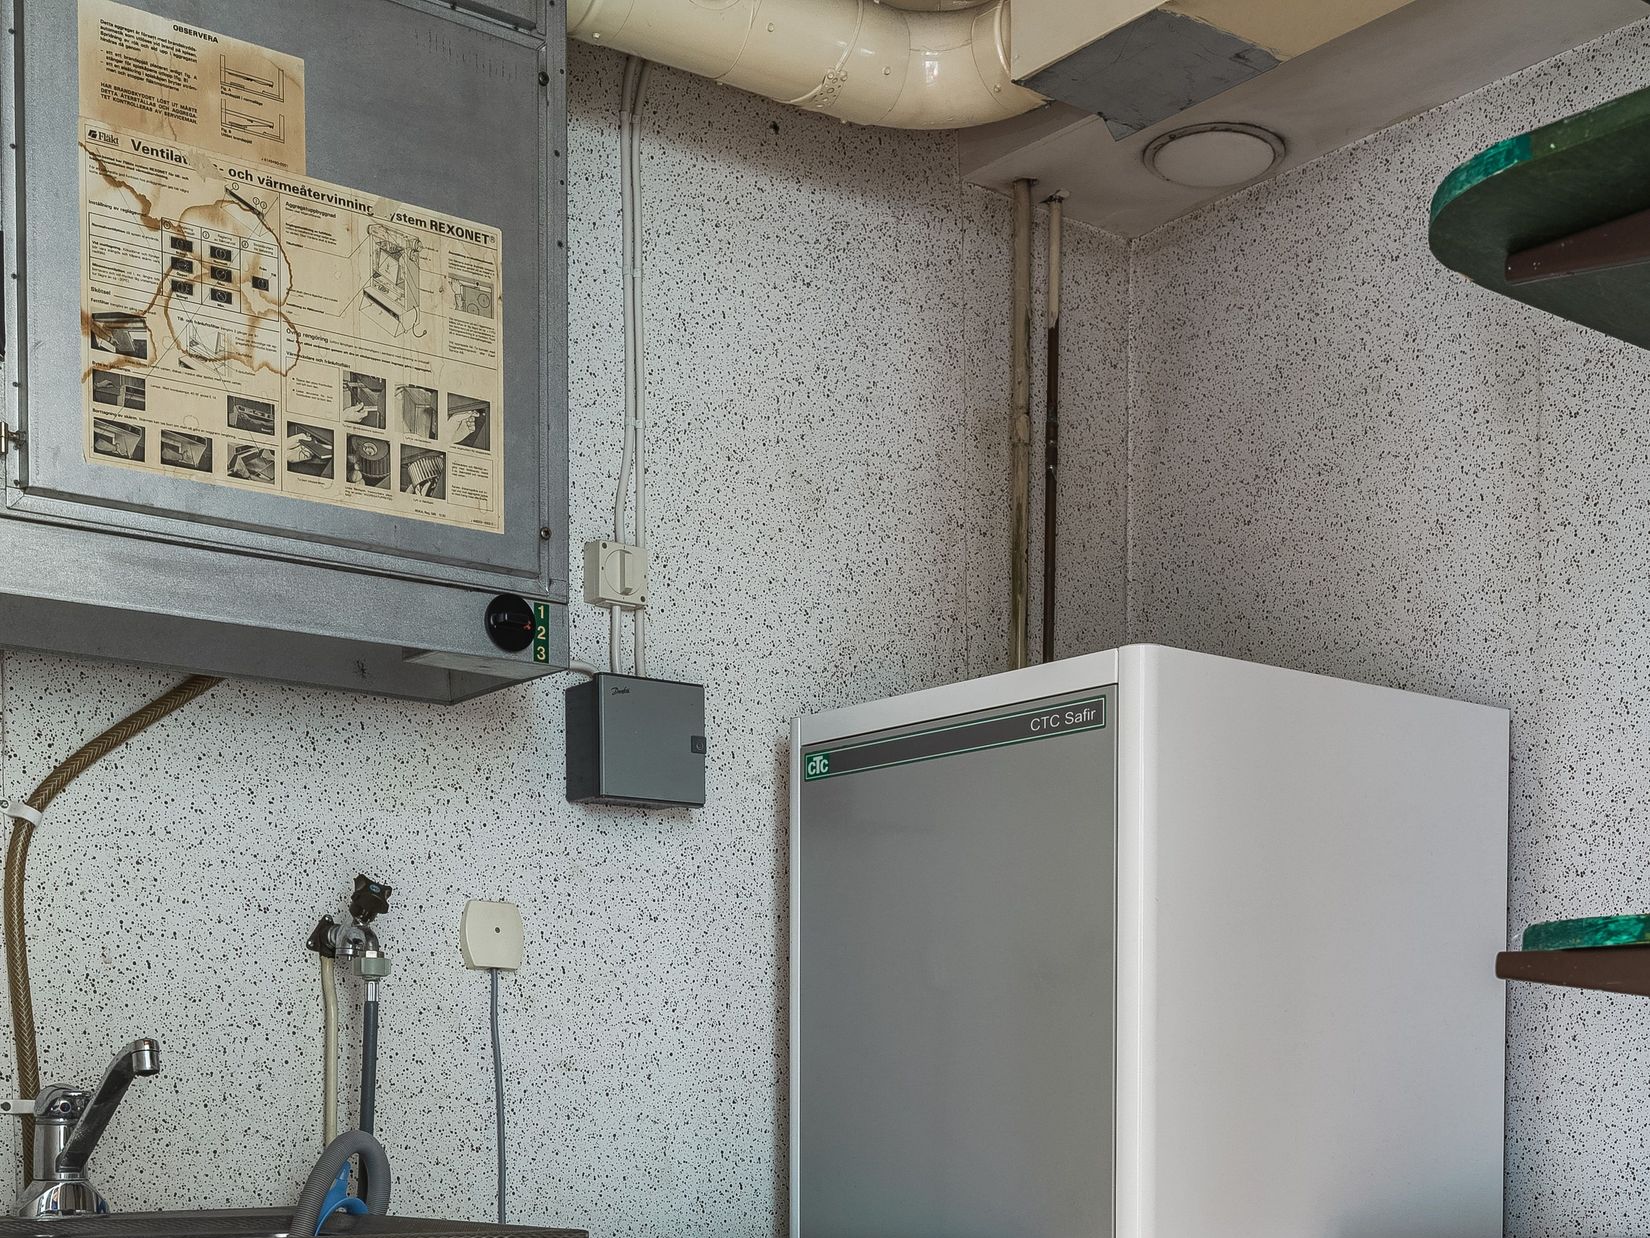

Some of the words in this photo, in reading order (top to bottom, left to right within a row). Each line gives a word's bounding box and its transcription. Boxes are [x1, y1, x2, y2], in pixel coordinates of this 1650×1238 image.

[173, 24, 219, 44] OBSERVERA
[98, 132, 120, 145] Fläkt
[228, 167, 253, 183] och
[90, 286, 111, 296] Skötsel
[302, 332, 329, 344] rengöring
[538, 605, 545, 619] 1
[537, 626, 546, 640] 2
[537, 646, 546, 660] 3
[1030, 713, 1060, 732] CTC
[1064, 709, 1097, 725] Safir
